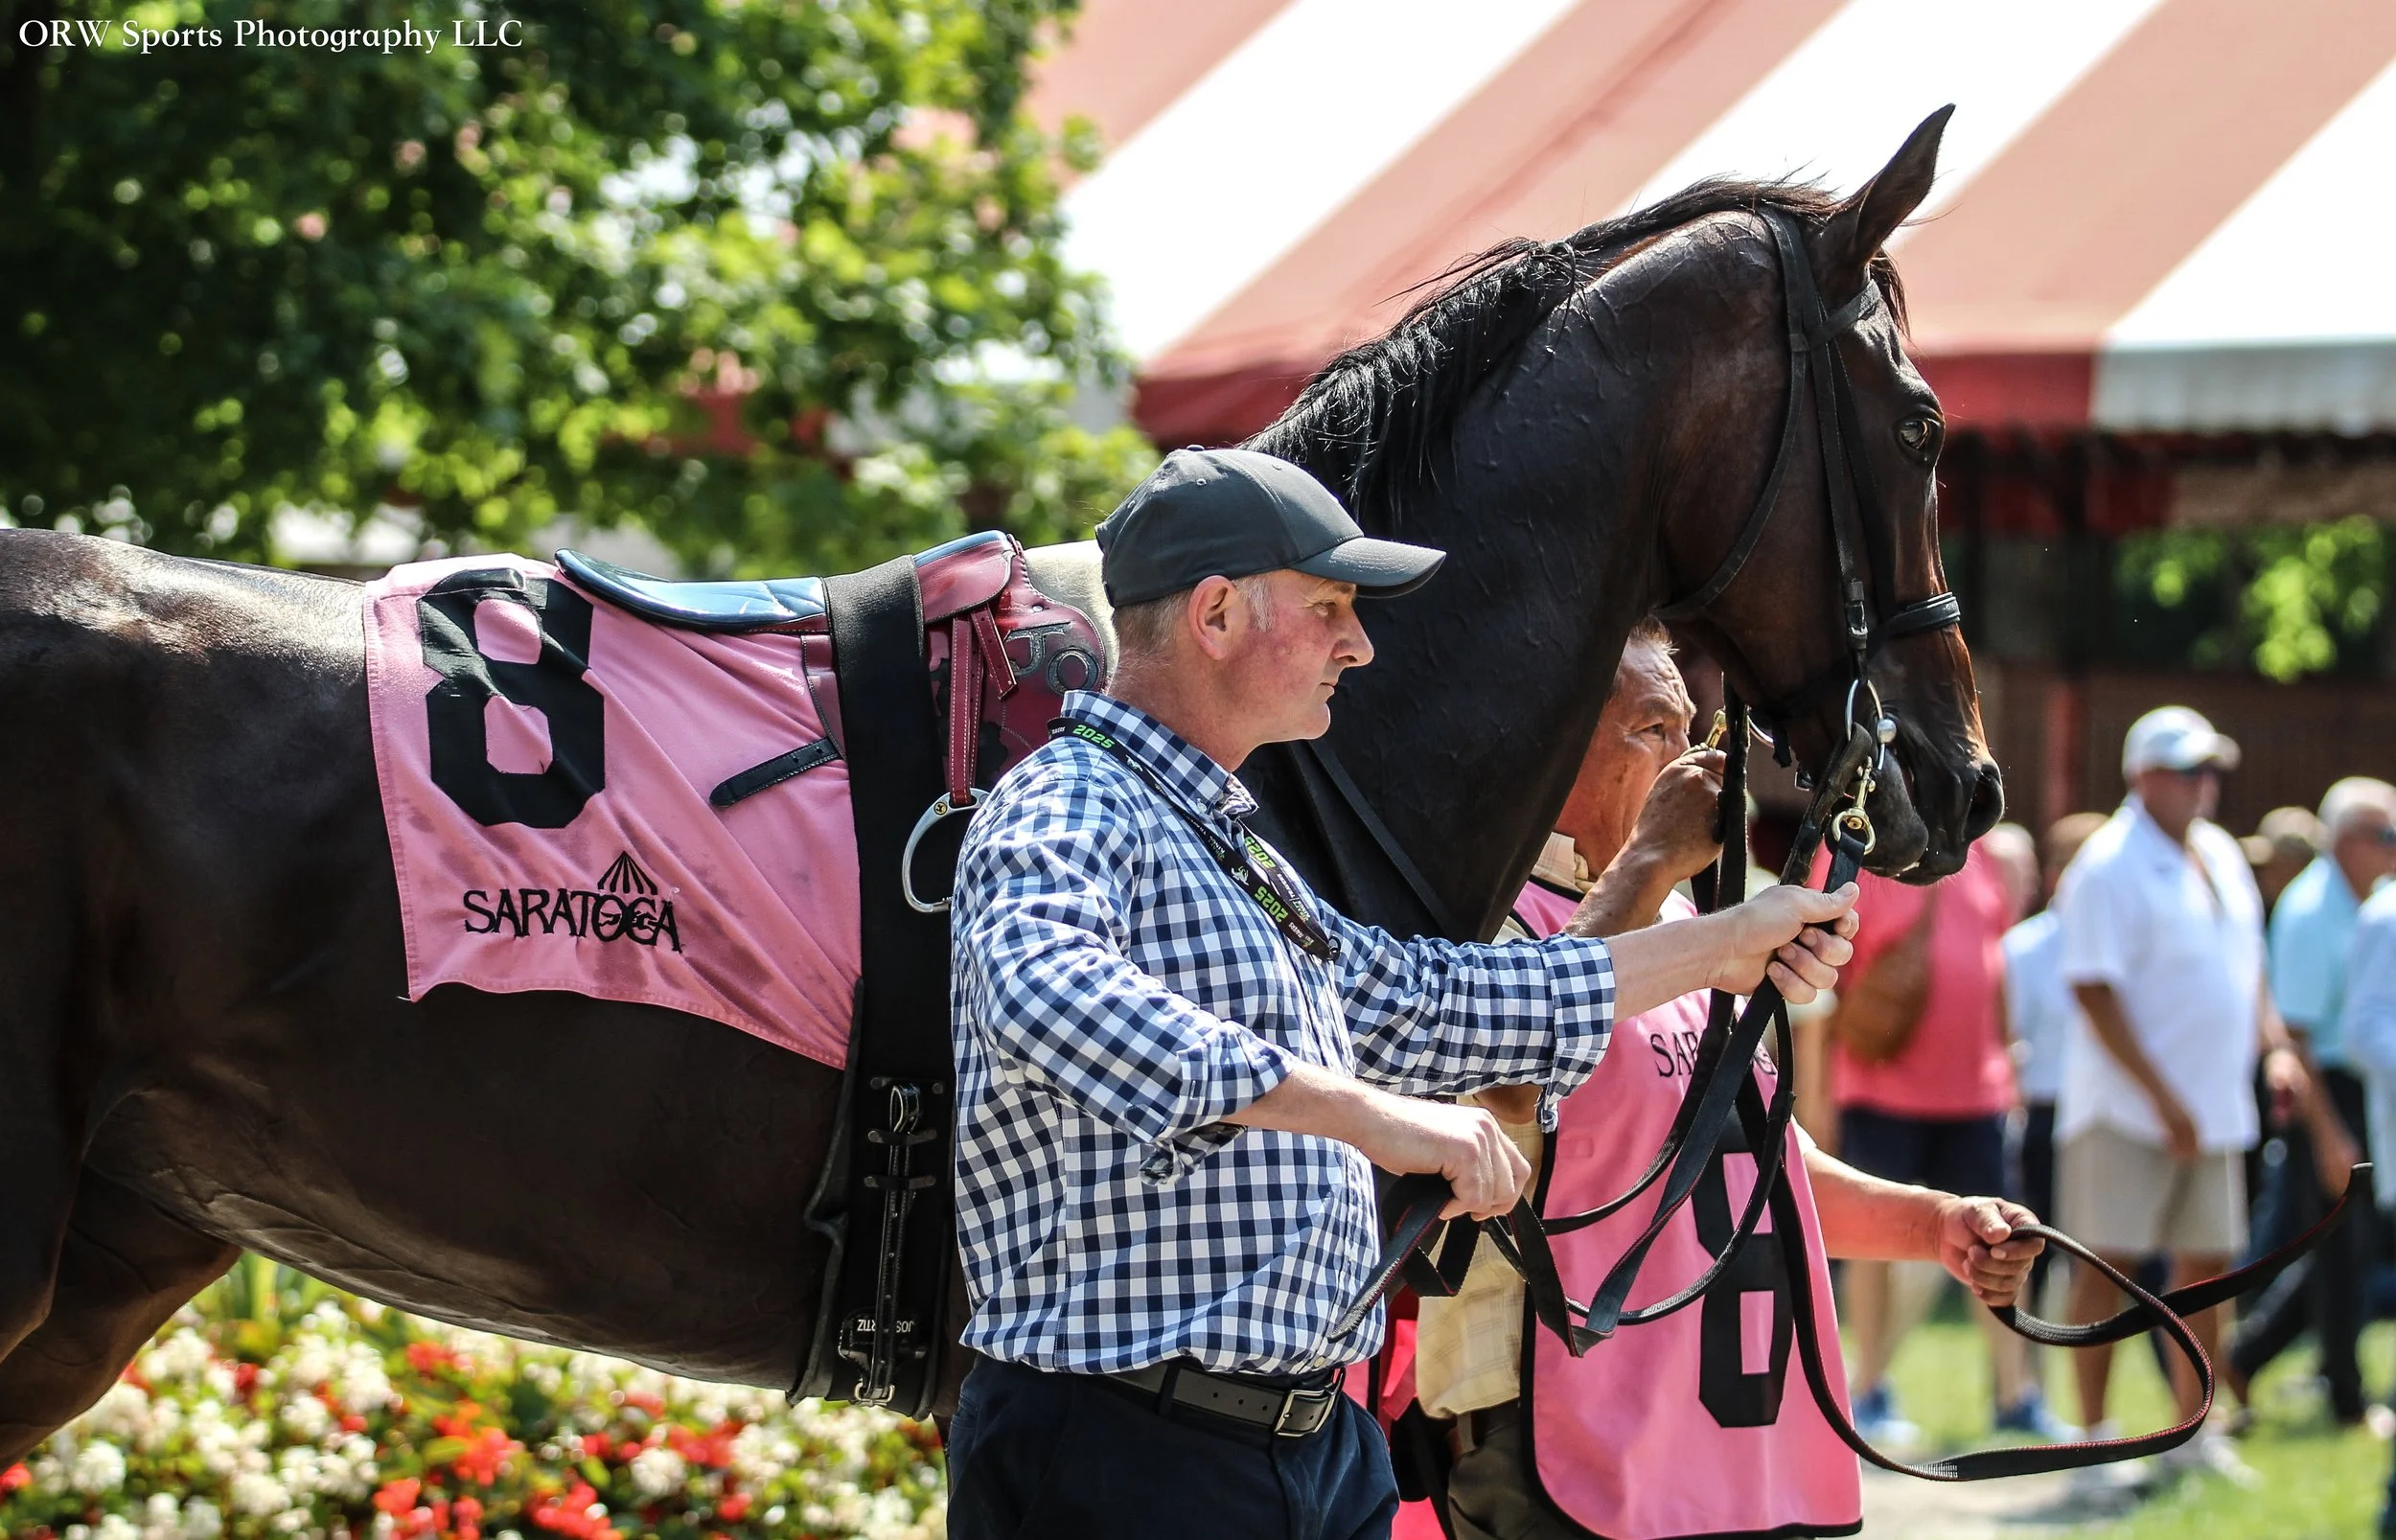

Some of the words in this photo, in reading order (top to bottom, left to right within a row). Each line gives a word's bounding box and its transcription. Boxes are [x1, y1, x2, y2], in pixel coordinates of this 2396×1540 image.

[416, 567, 606, 830] 8
[1072, 724, 1116, 748] 2025
[1245, 836, 1277, 869] 2025
[1254, 885, 1289, 923] 2025
[462, 887, 683, 955] SARATOGA
[857, 1319, 876, 1332] RTIZ
[895, 1320, 915, 1334] JOS
